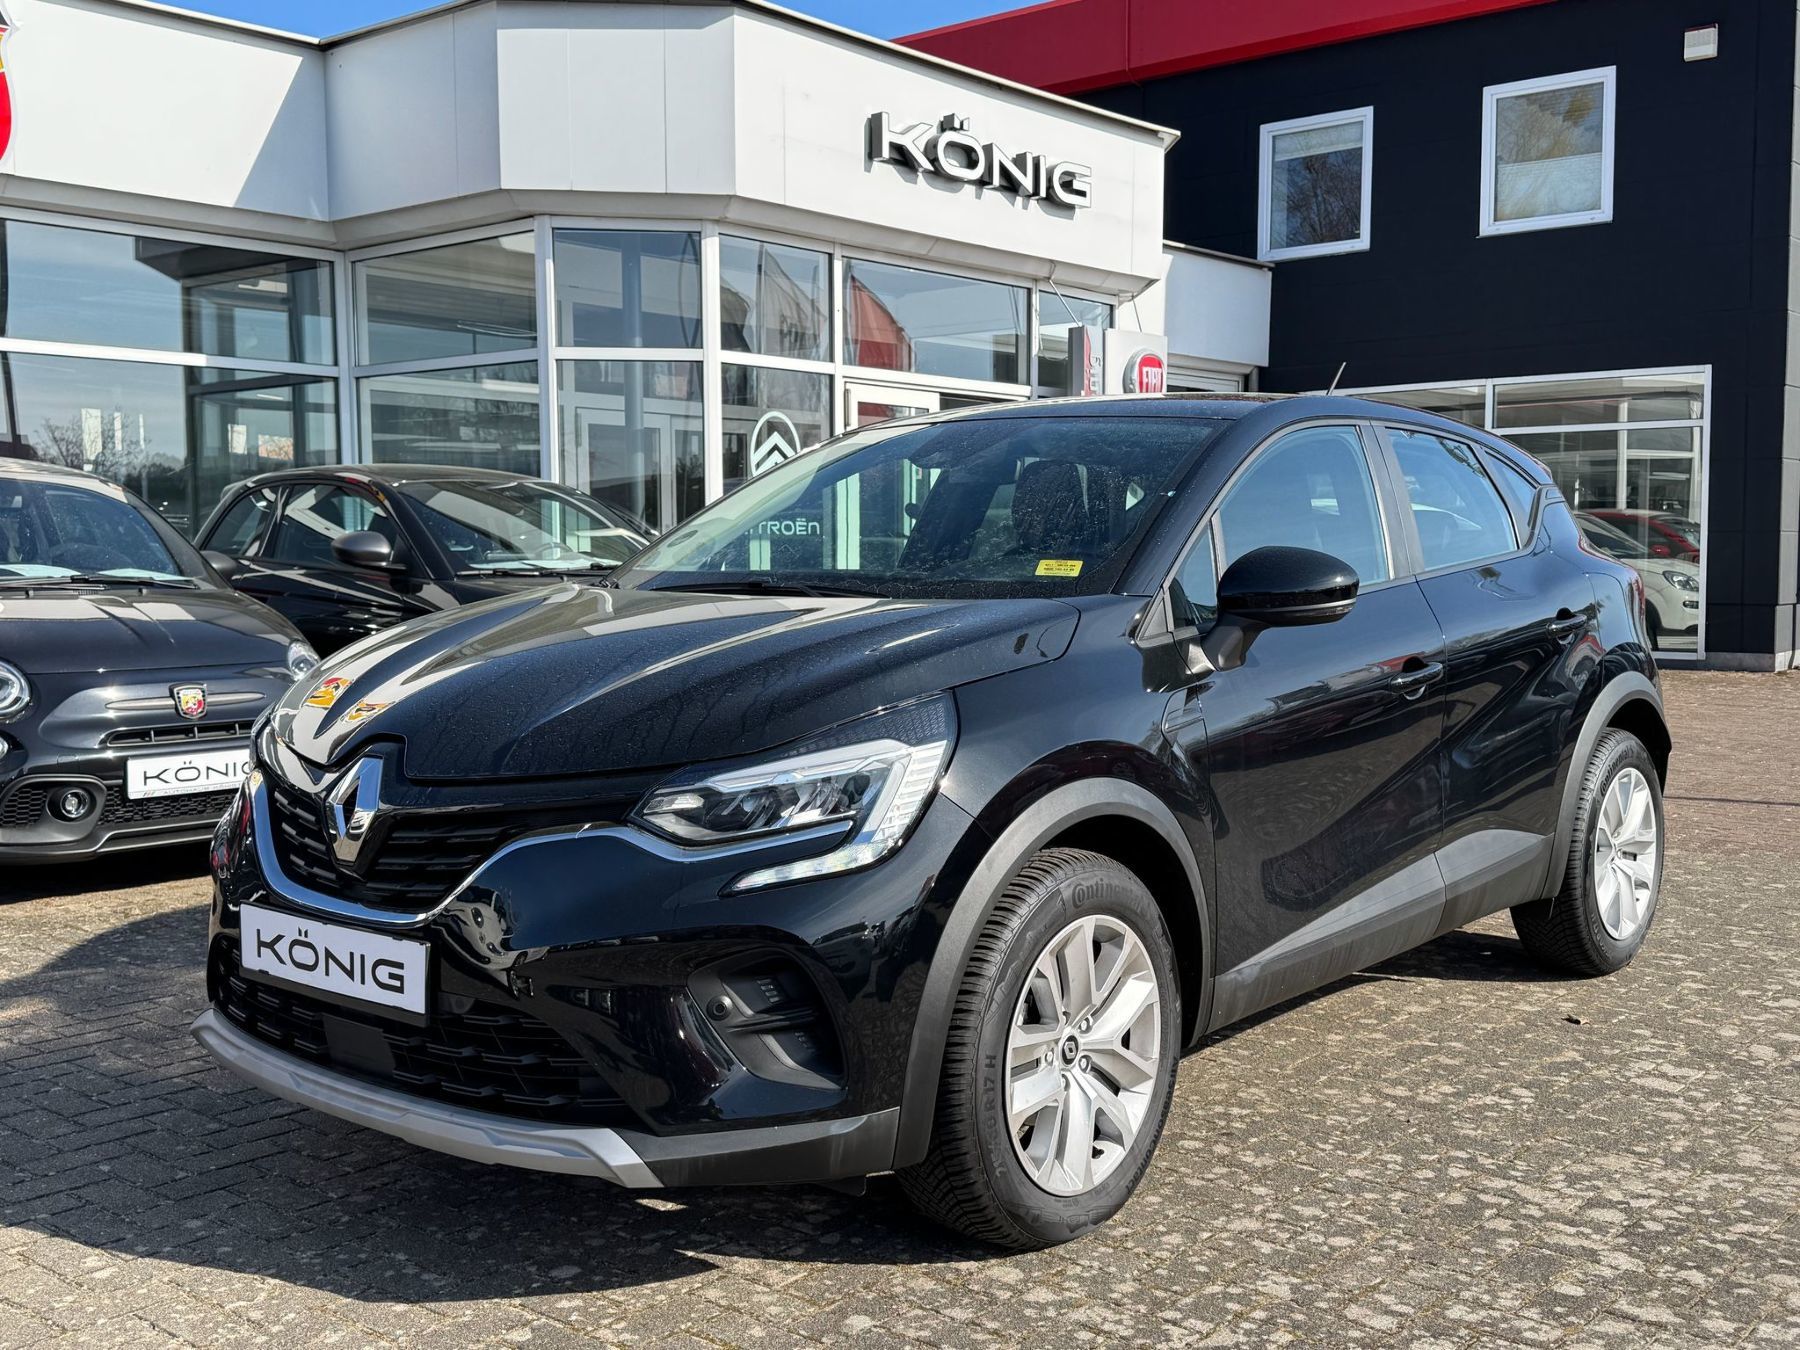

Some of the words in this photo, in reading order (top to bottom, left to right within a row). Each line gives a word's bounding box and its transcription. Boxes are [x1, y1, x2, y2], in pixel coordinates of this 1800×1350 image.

[870, 112, 1092, 208] KÖNIG
[1141, 366, 1163, 393] FIAT
[256, 926, 405, 994] KÖNIG
